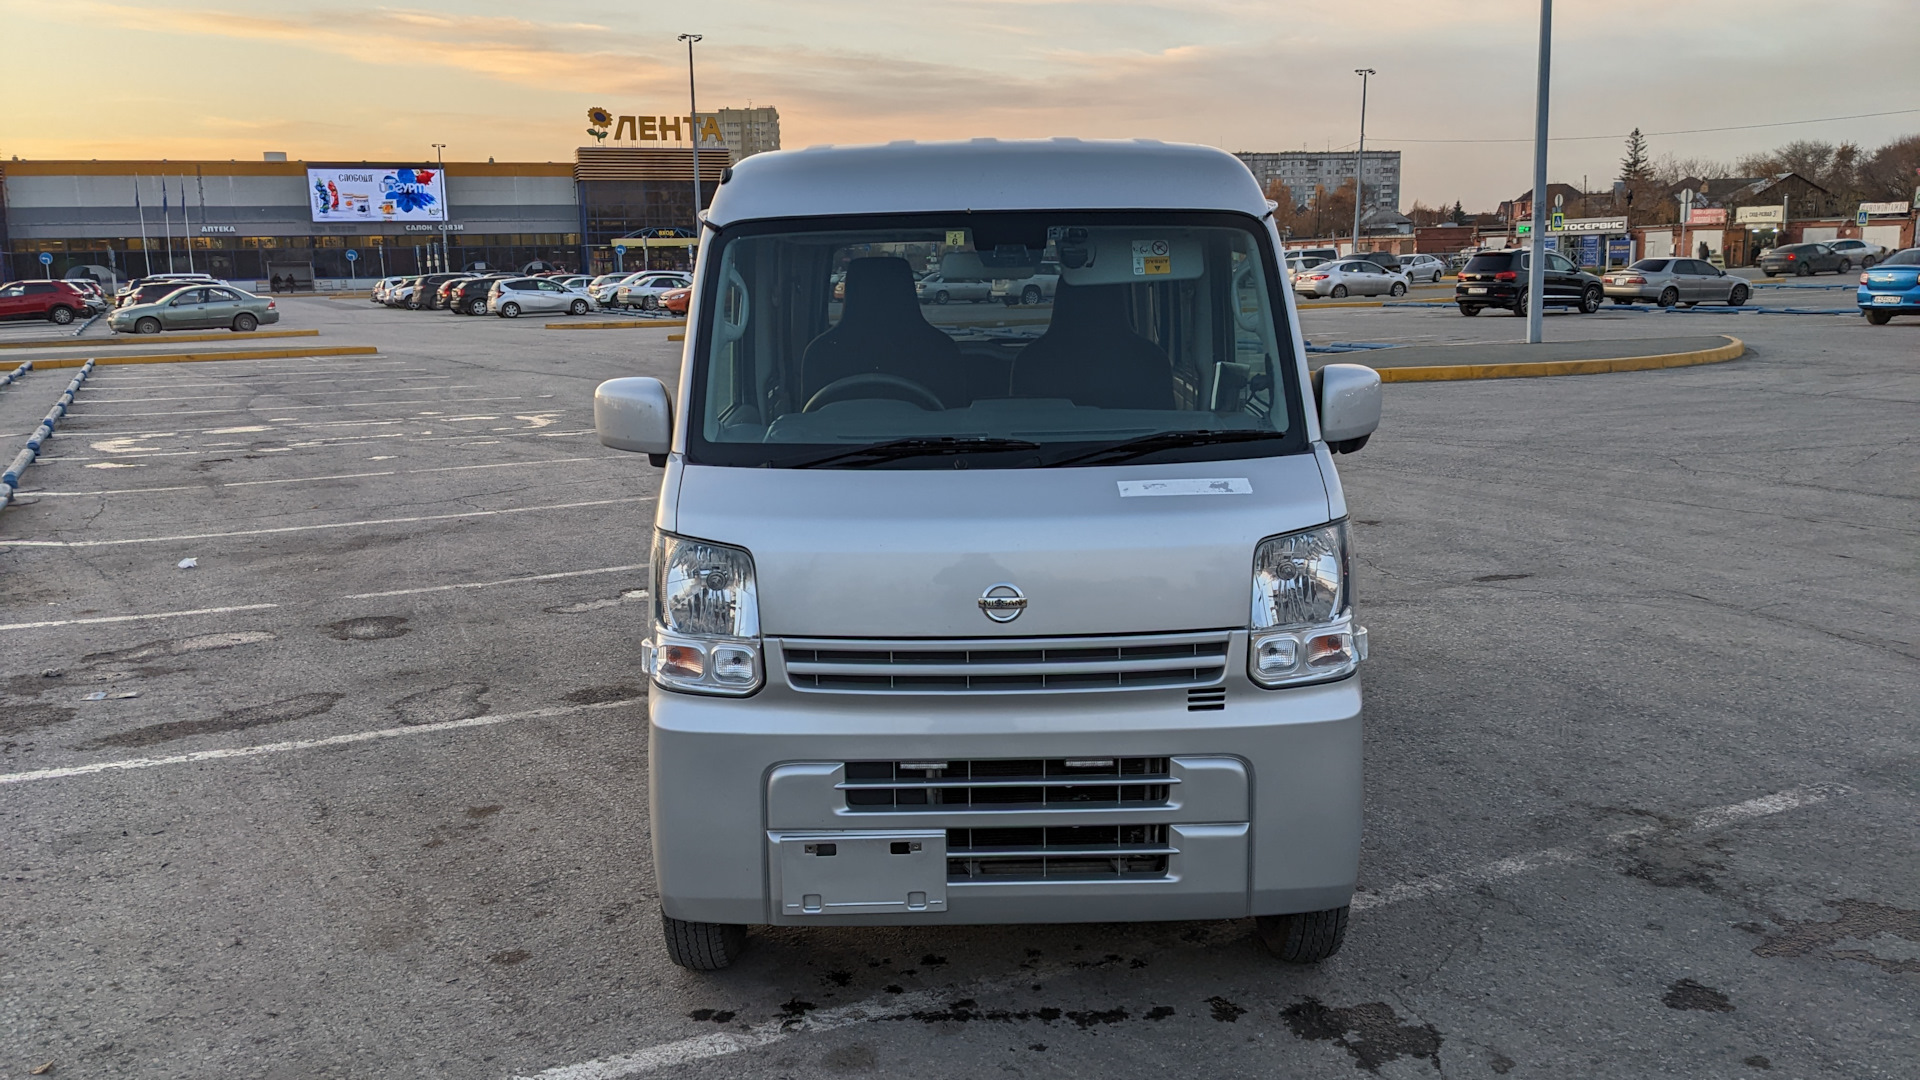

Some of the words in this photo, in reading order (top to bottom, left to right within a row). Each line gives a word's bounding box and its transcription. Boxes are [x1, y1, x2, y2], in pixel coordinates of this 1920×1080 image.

[614, 115, 724, 142] ЛЕНТА
[201, 225, 236, 233] АПТЕКА
[984, 599, 1022, 607] NISSAN
